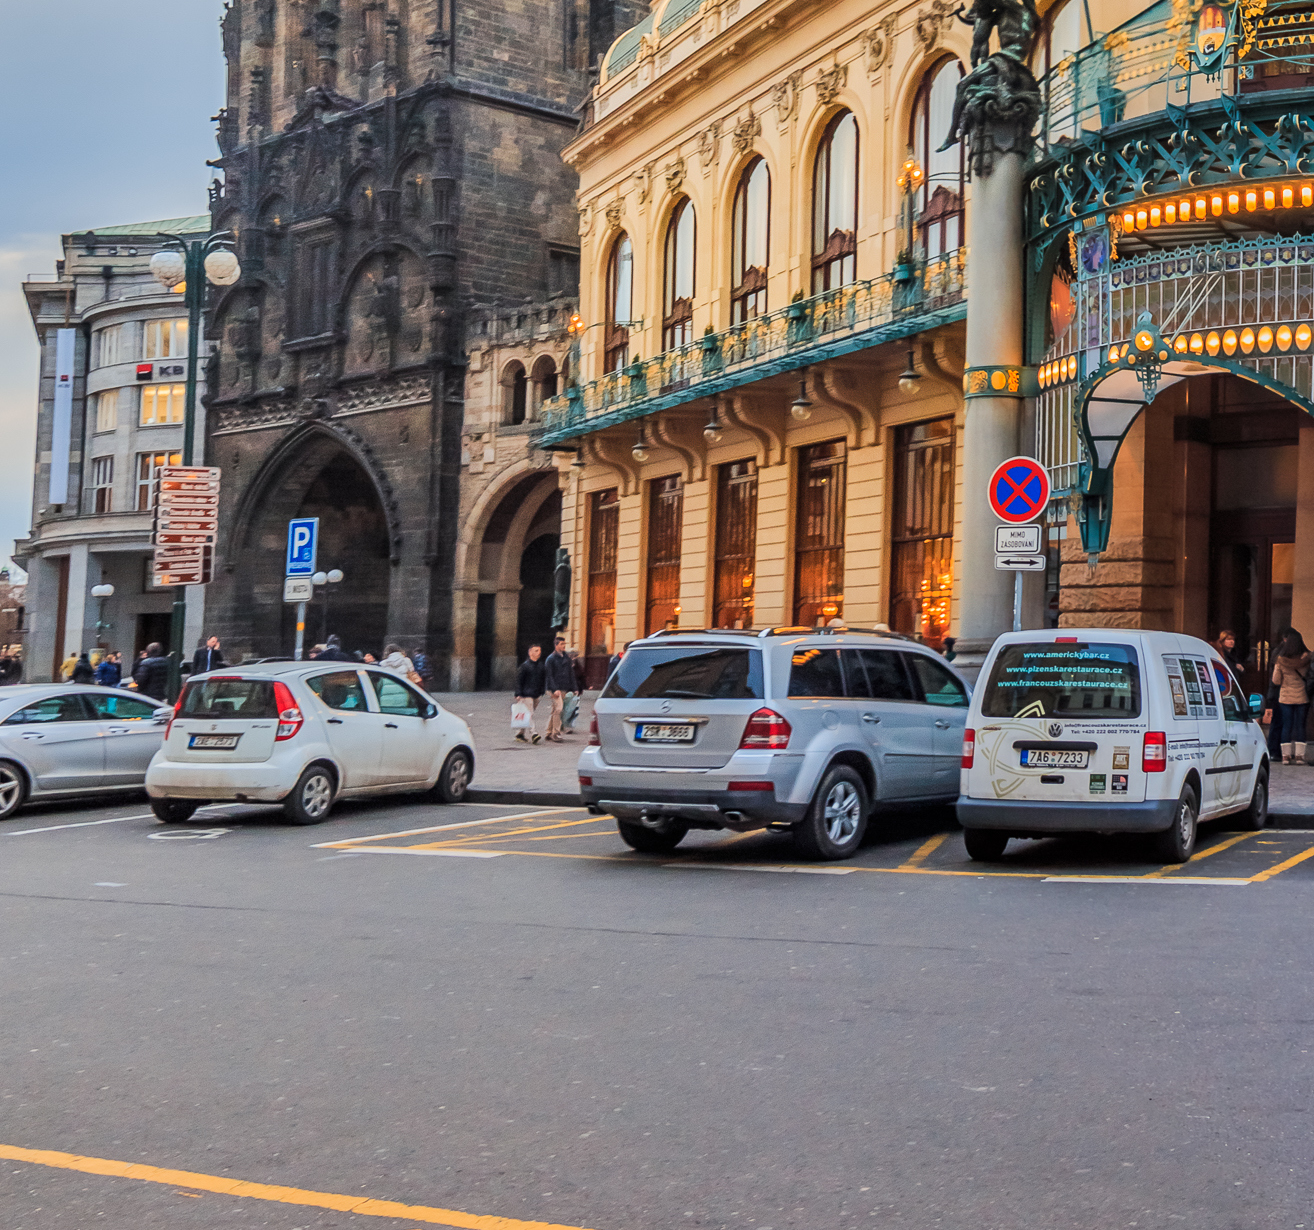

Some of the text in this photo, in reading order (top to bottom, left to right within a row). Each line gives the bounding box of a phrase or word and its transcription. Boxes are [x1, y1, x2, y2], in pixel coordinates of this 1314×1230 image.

[159, 366, 184, 376] KB
[293, 526, 310, 558] P
[1023, 651, 1110, 660] www.americkybar.cz
[1006, 666, 1123, 674] www.plzenskarestaurace.cz
[997, 680, 1128, 689] www.francouzskarestaurace.cz
[1030, 751, 1083, 764] 7A6 7233
